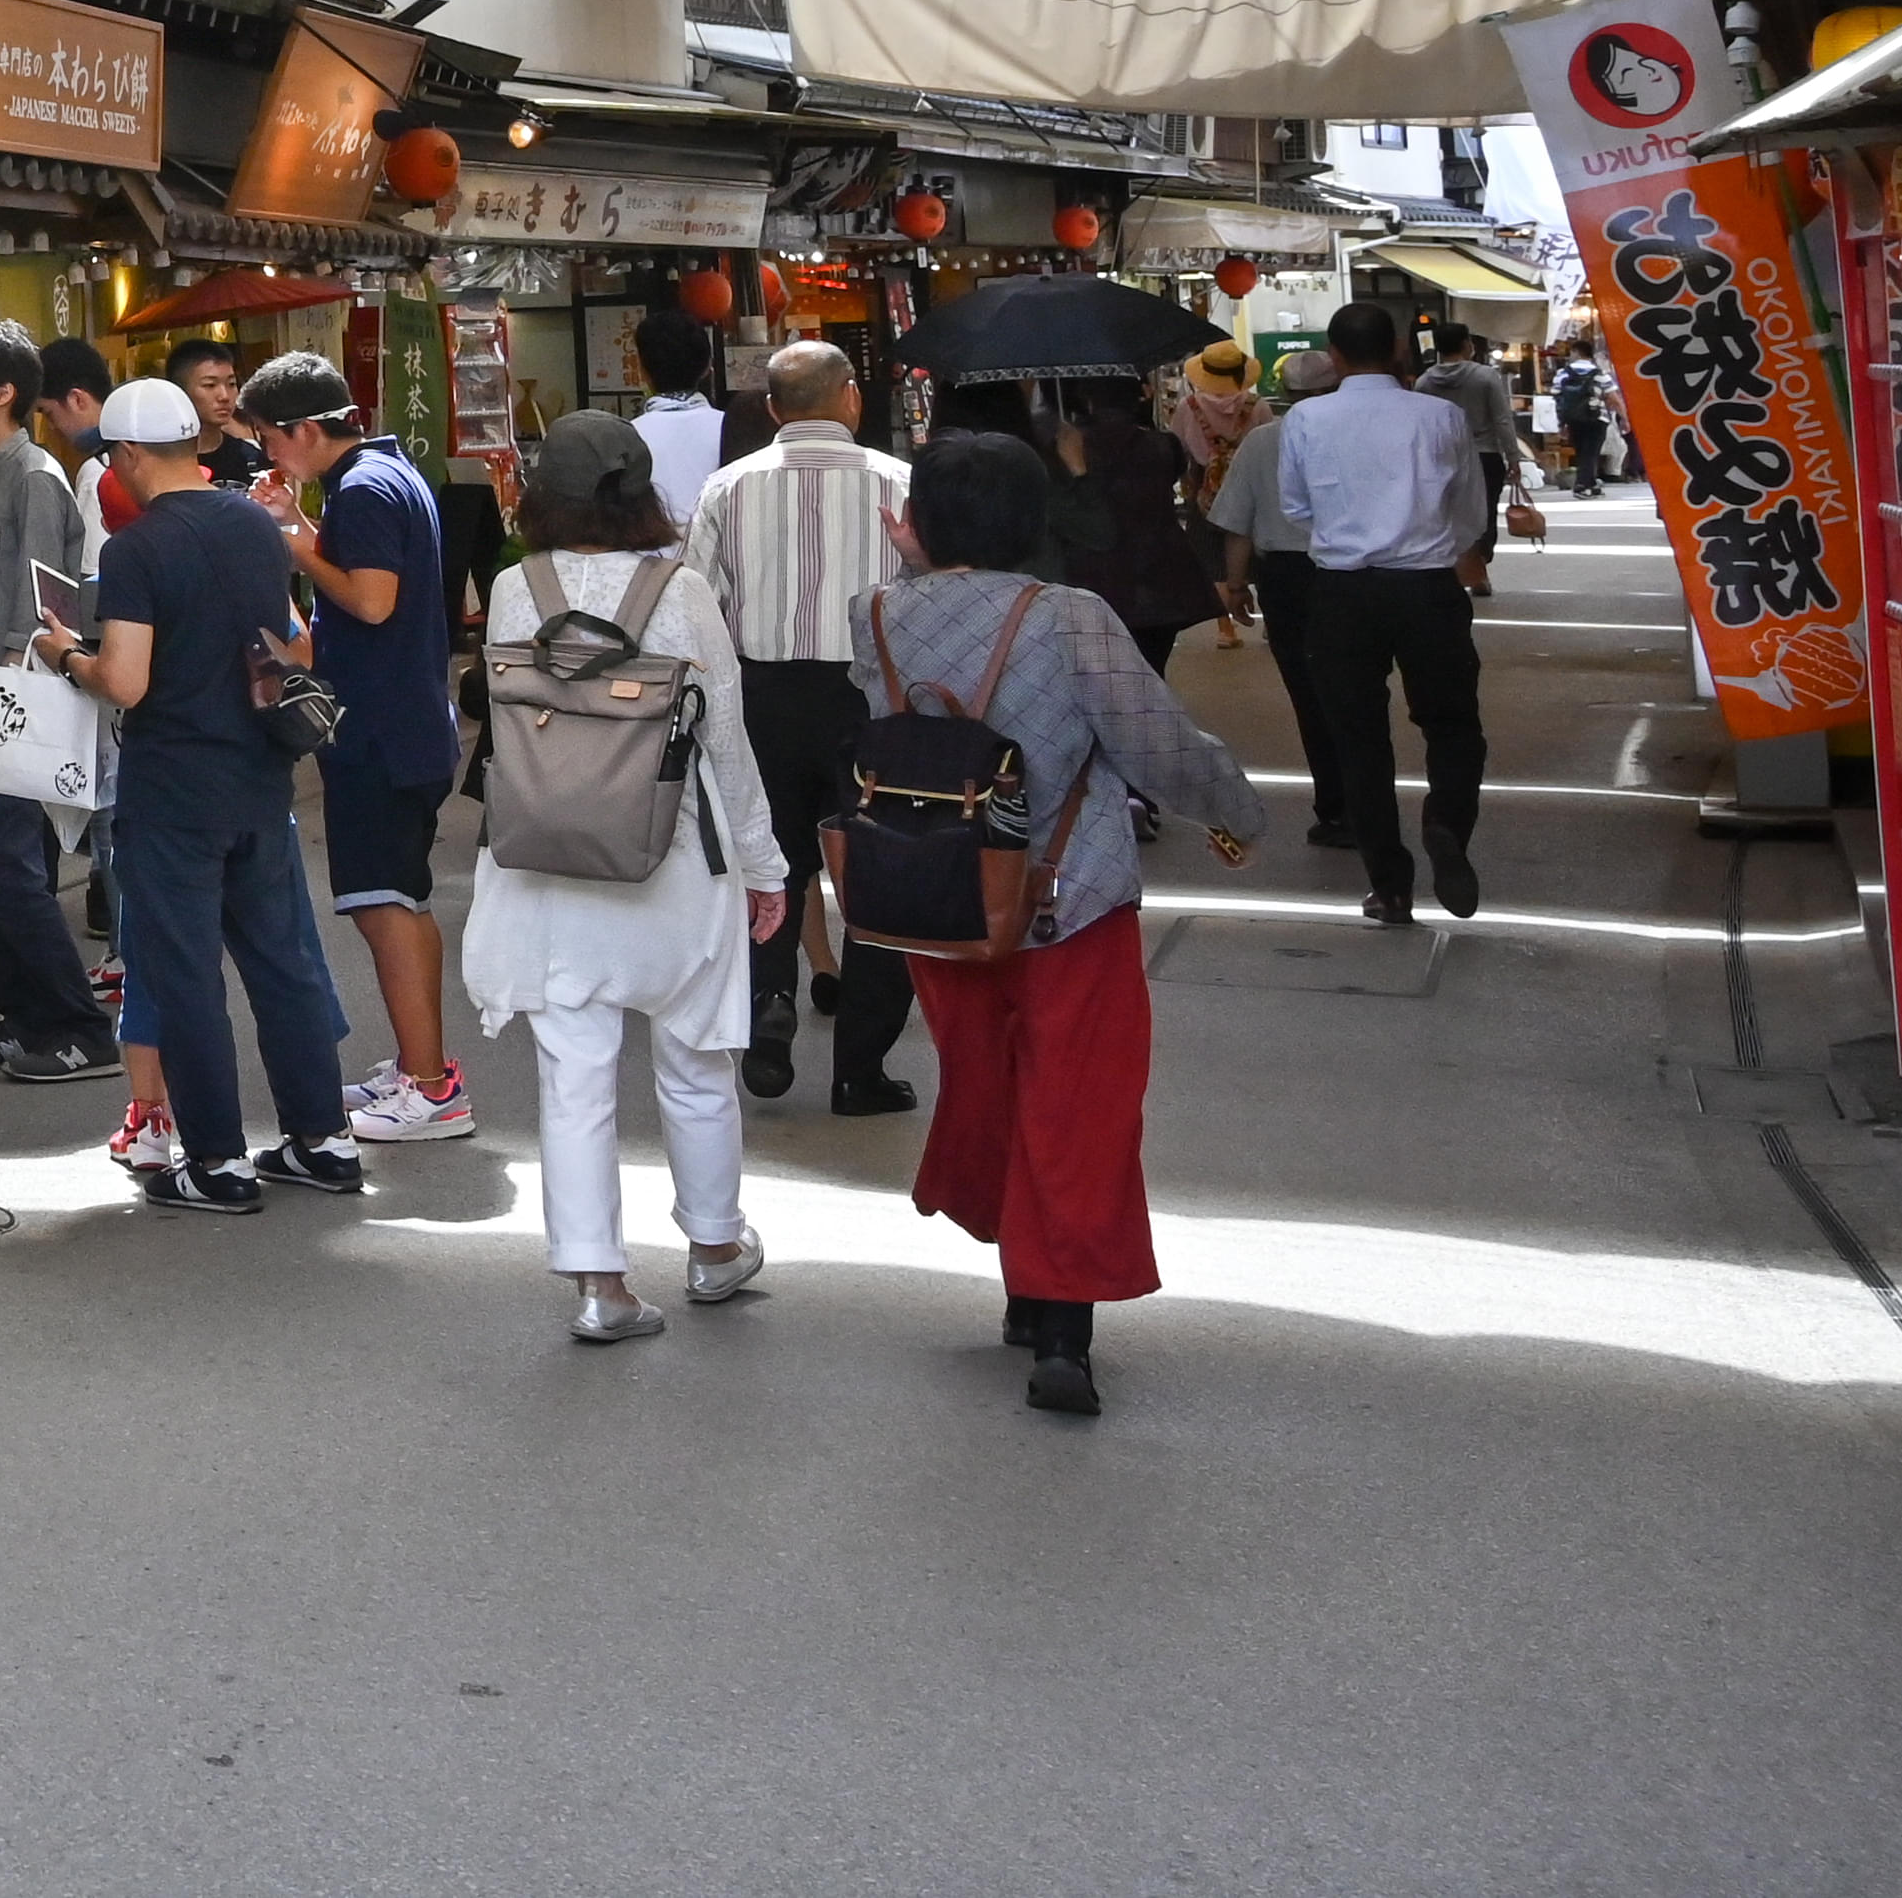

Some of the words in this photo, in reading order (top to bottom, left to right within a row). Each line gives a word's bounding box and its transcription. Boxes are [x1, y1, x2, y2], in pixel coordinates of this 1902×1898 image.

[47, 37, 149, 115] 本わらび餅
[9, 95, 57, 122] JAPANESE
[61, 103, 99, 129] MACCHA
[102, 111, 136, 135] SWEETS
[523, 182, 623, 238] きむら
